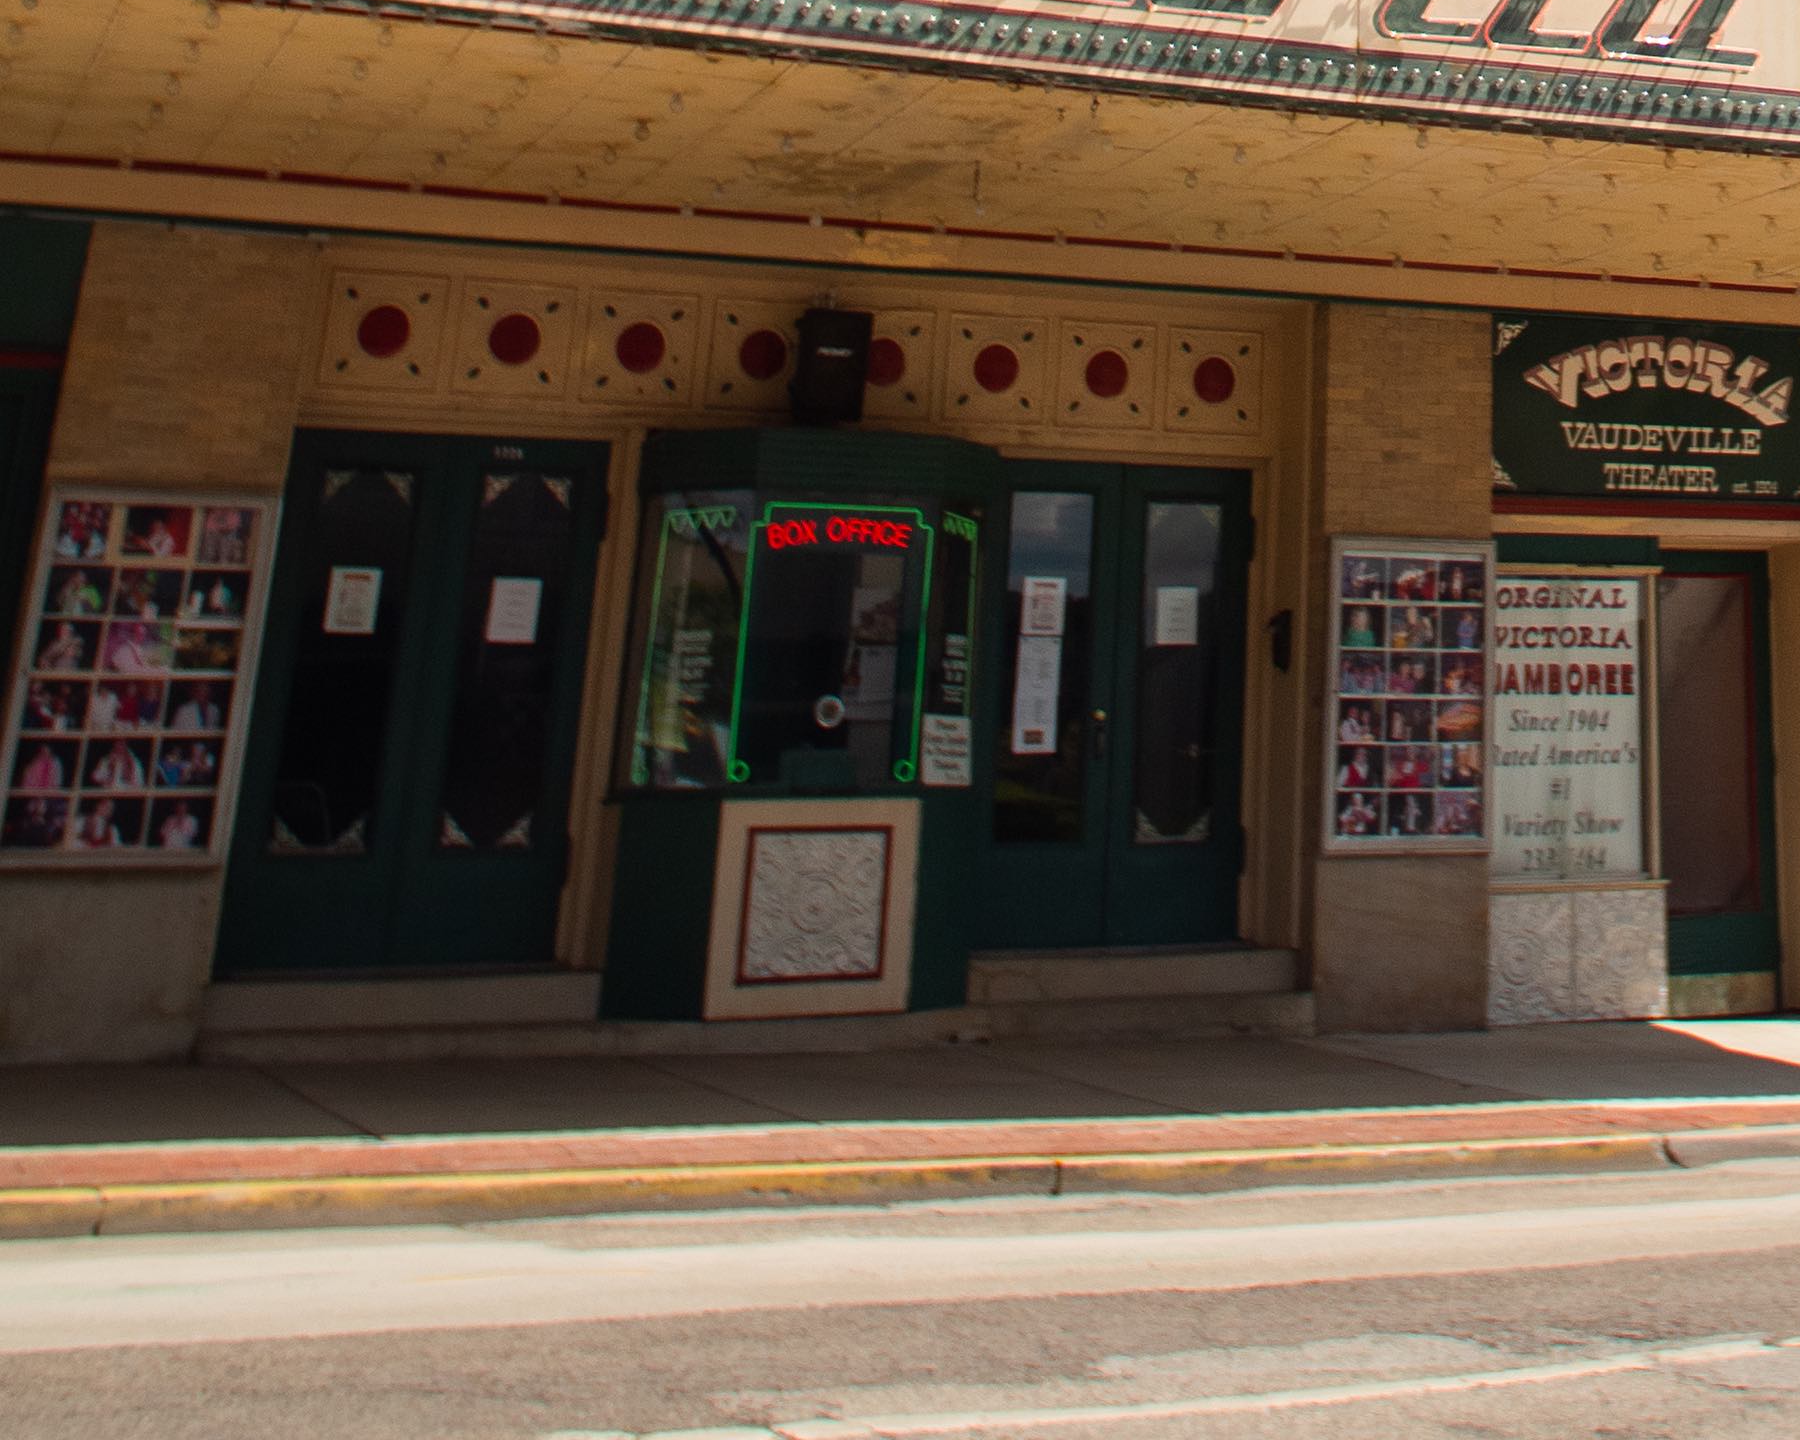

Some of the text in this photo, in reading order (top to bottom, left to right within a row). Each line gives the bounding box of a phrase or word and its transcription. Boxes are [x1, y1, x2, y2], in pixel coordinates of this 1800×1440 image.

[1522, 335, 1794, 427] VICTORIA
[1560, 421, 1762, 455] VAUDEVILLE
[1603, 462, 1719, 493] THEATER
[767, 516, 913, 550] BOX OFFICE
[1495, 626, 1632, 648] VICTORIA
[1493, 663, 1634, 695] JAMBOREE
[1509, 709, 1561, 731] Since
[1544, 742, 1639, 766] America's
[1573, 808, 1624, 834] Show
